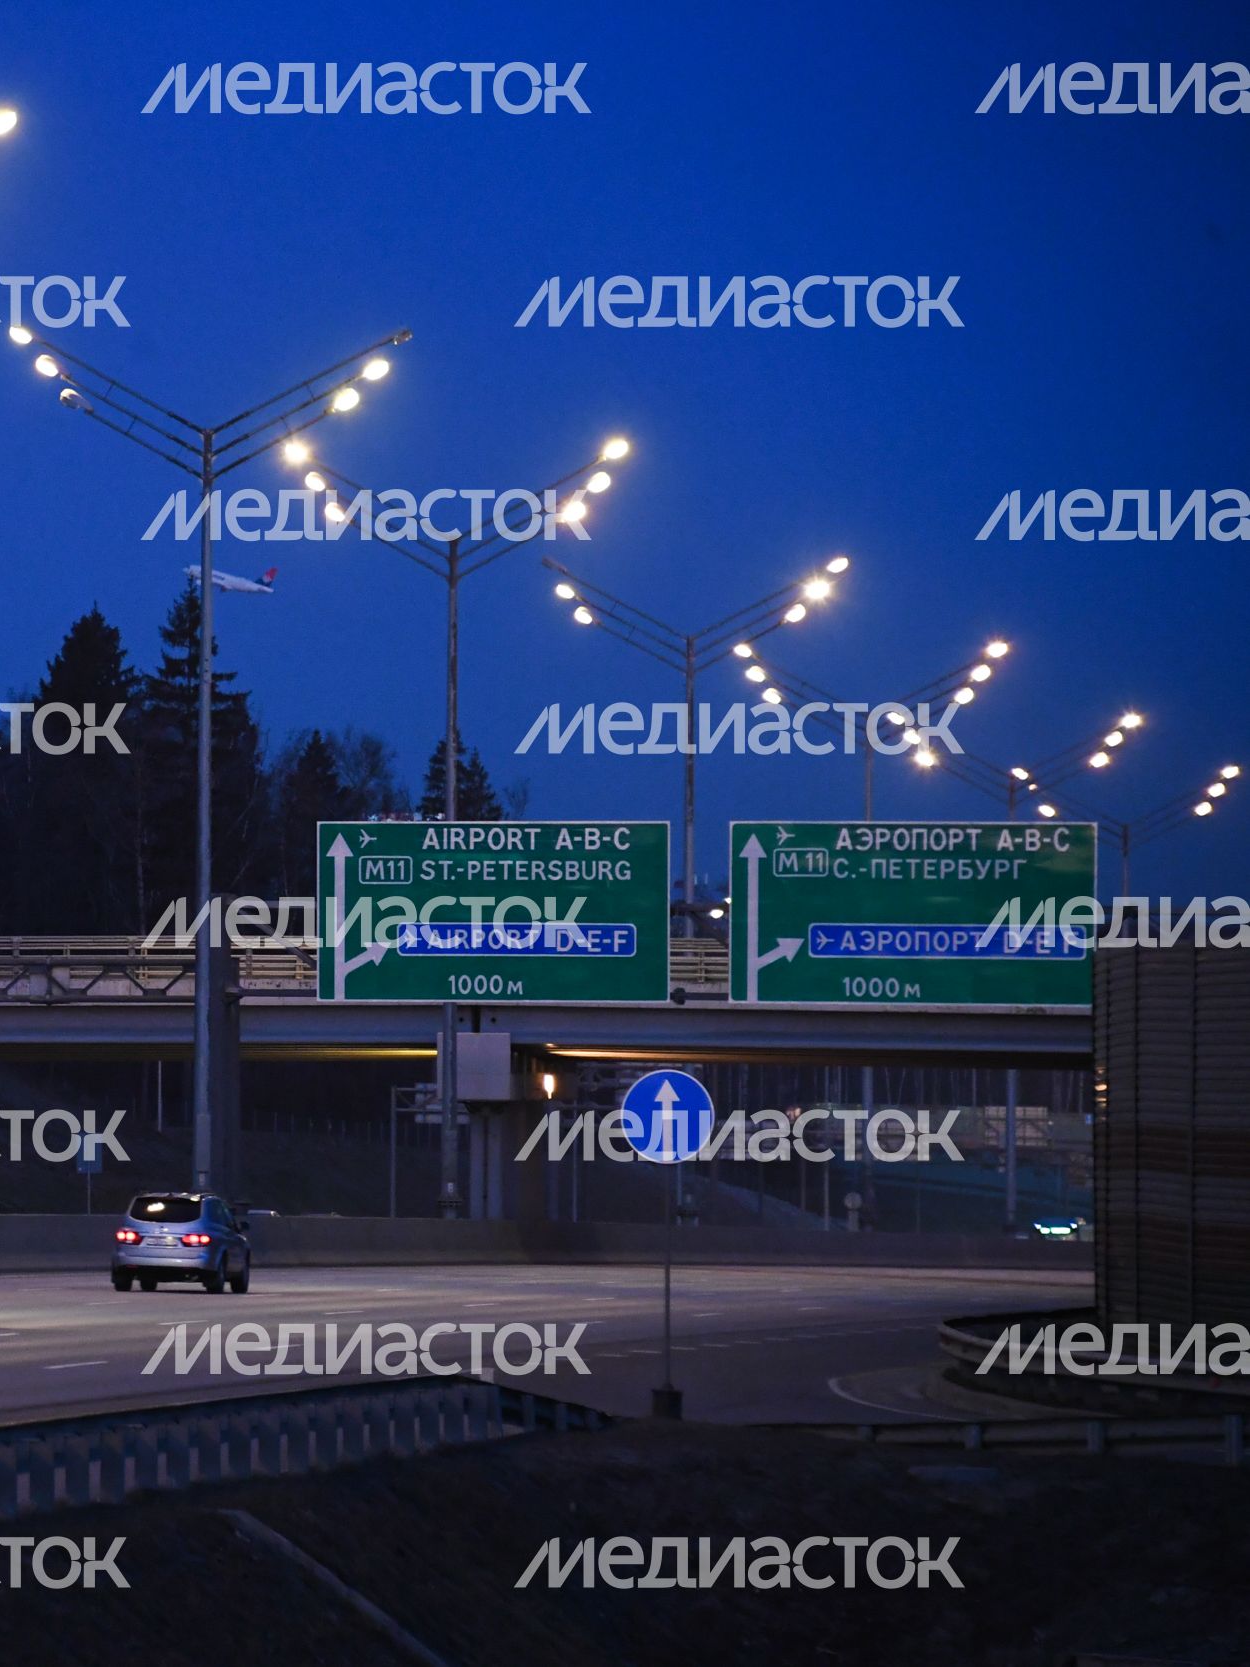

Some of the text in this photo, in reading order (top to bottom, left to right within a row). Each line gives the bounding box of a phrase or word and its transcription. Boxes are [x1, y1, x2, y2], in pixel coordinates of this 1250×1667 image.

[422, 827, 631, 851] AIRPORT A-B-C
[835, 827, 982, 851] АЭРОПОРТ
[420, 860, 631, 881] ST.-PETERSBURG
[833, 858, 1027, 880] С.-ПЕТЕРБУРГ
[427, 929, 628, 953] AIRPORT D-E-F
[840, 930, 985, 952] АЭРОПОРТ
